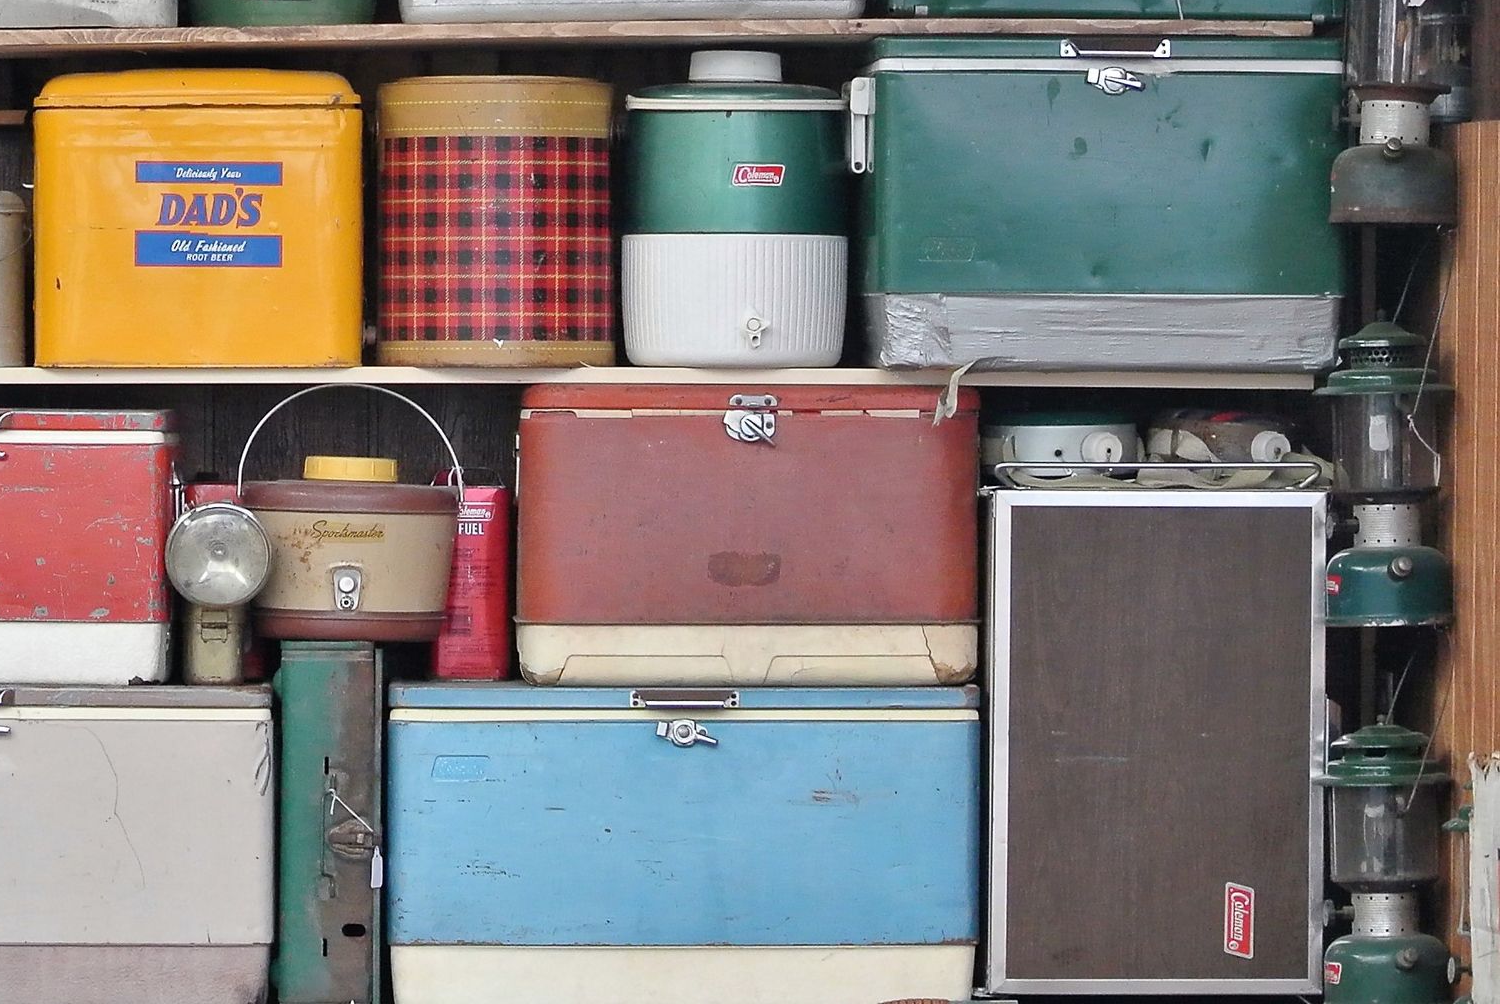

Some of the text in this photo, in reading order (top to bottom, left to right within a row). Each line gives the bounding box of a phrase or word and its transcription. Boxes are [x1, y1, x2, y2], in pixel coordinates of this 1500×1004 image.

[738, 167, 775, 182] Coleman
[154, 187, 263, 229] DAD'S
[171, 239, 247, 253] Old Fashioned
[186, 253, 233, 263] ROOT BEER
[459, 504, 486, 516] oleman
[311, 519, 384, 542] Sportsmaster
[458, 522, 485, 535] FUEL
[1230, 891, 1250, 942] Coleman
